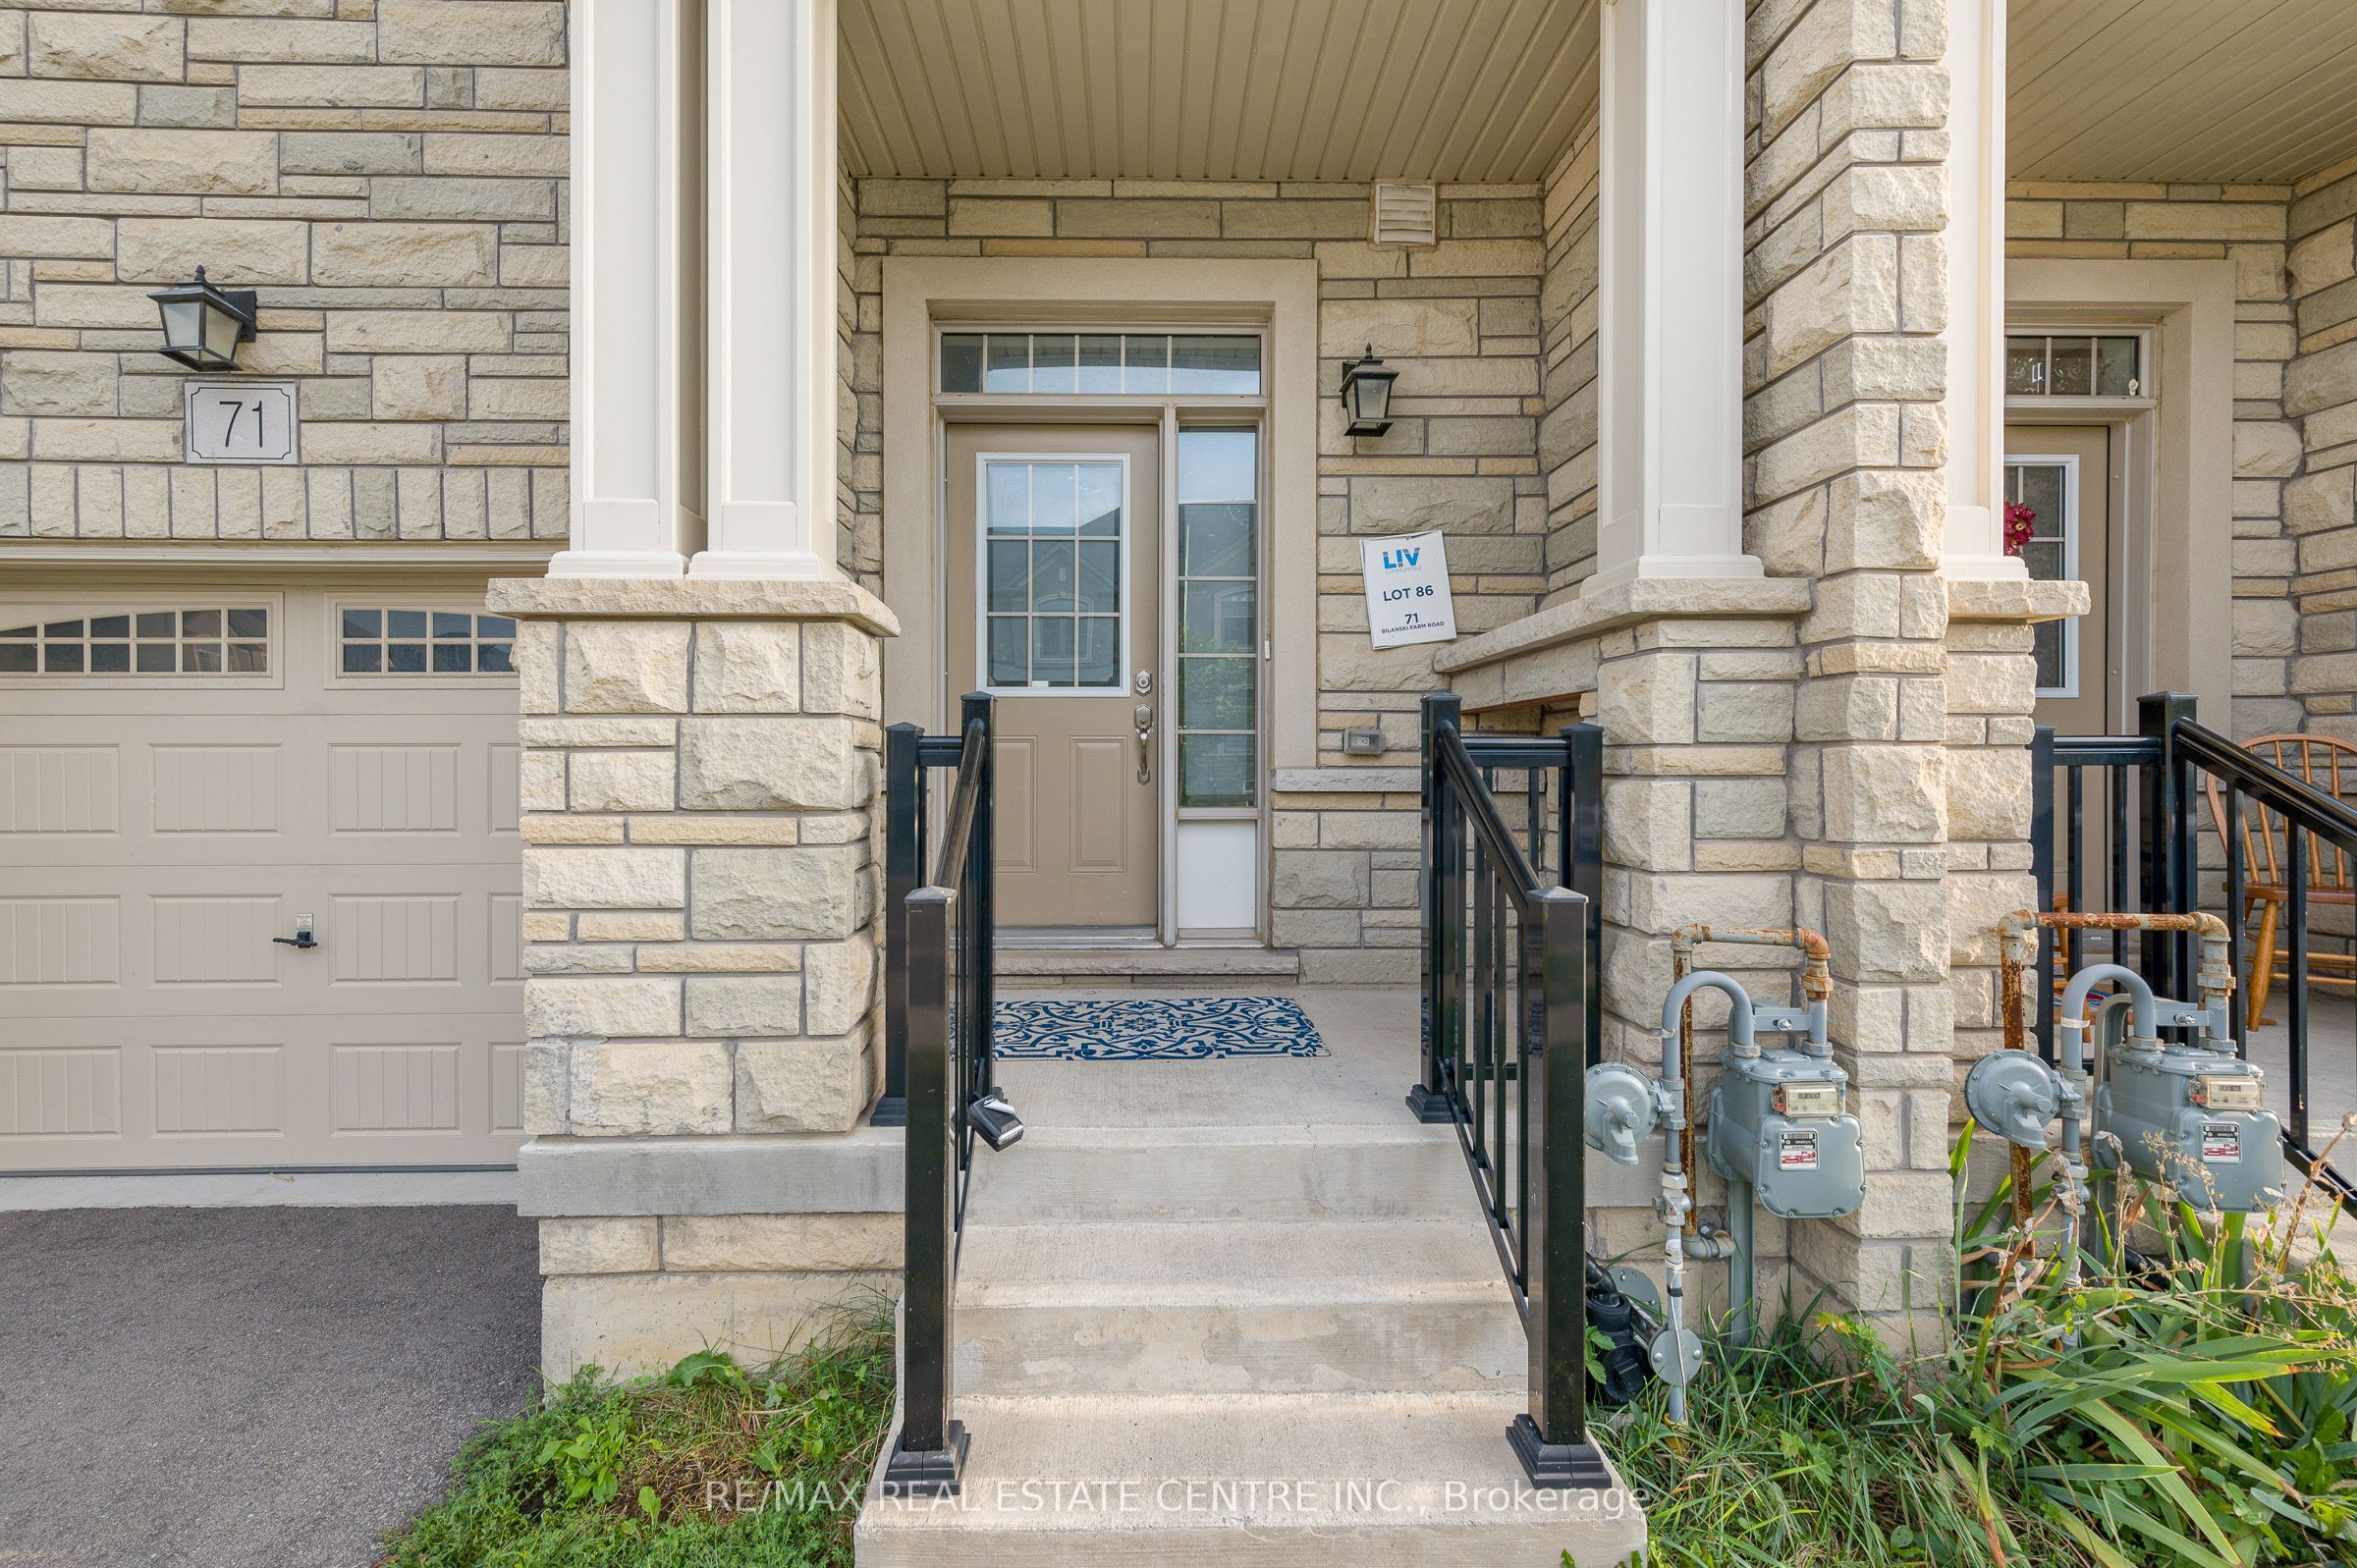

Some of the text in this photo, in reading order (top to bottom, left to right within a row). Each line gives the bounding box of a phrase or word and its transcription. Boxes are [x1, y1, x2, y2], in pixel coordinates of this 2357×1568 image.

[219, 401, 263, 448] 71
[1383, 547, 1420, 569] LIV
[1383, 585, 1434, 602] LOT 86
[1404, 613, 1419, 624] 71
[1381, 625, 1409, 634] BILANSKI
